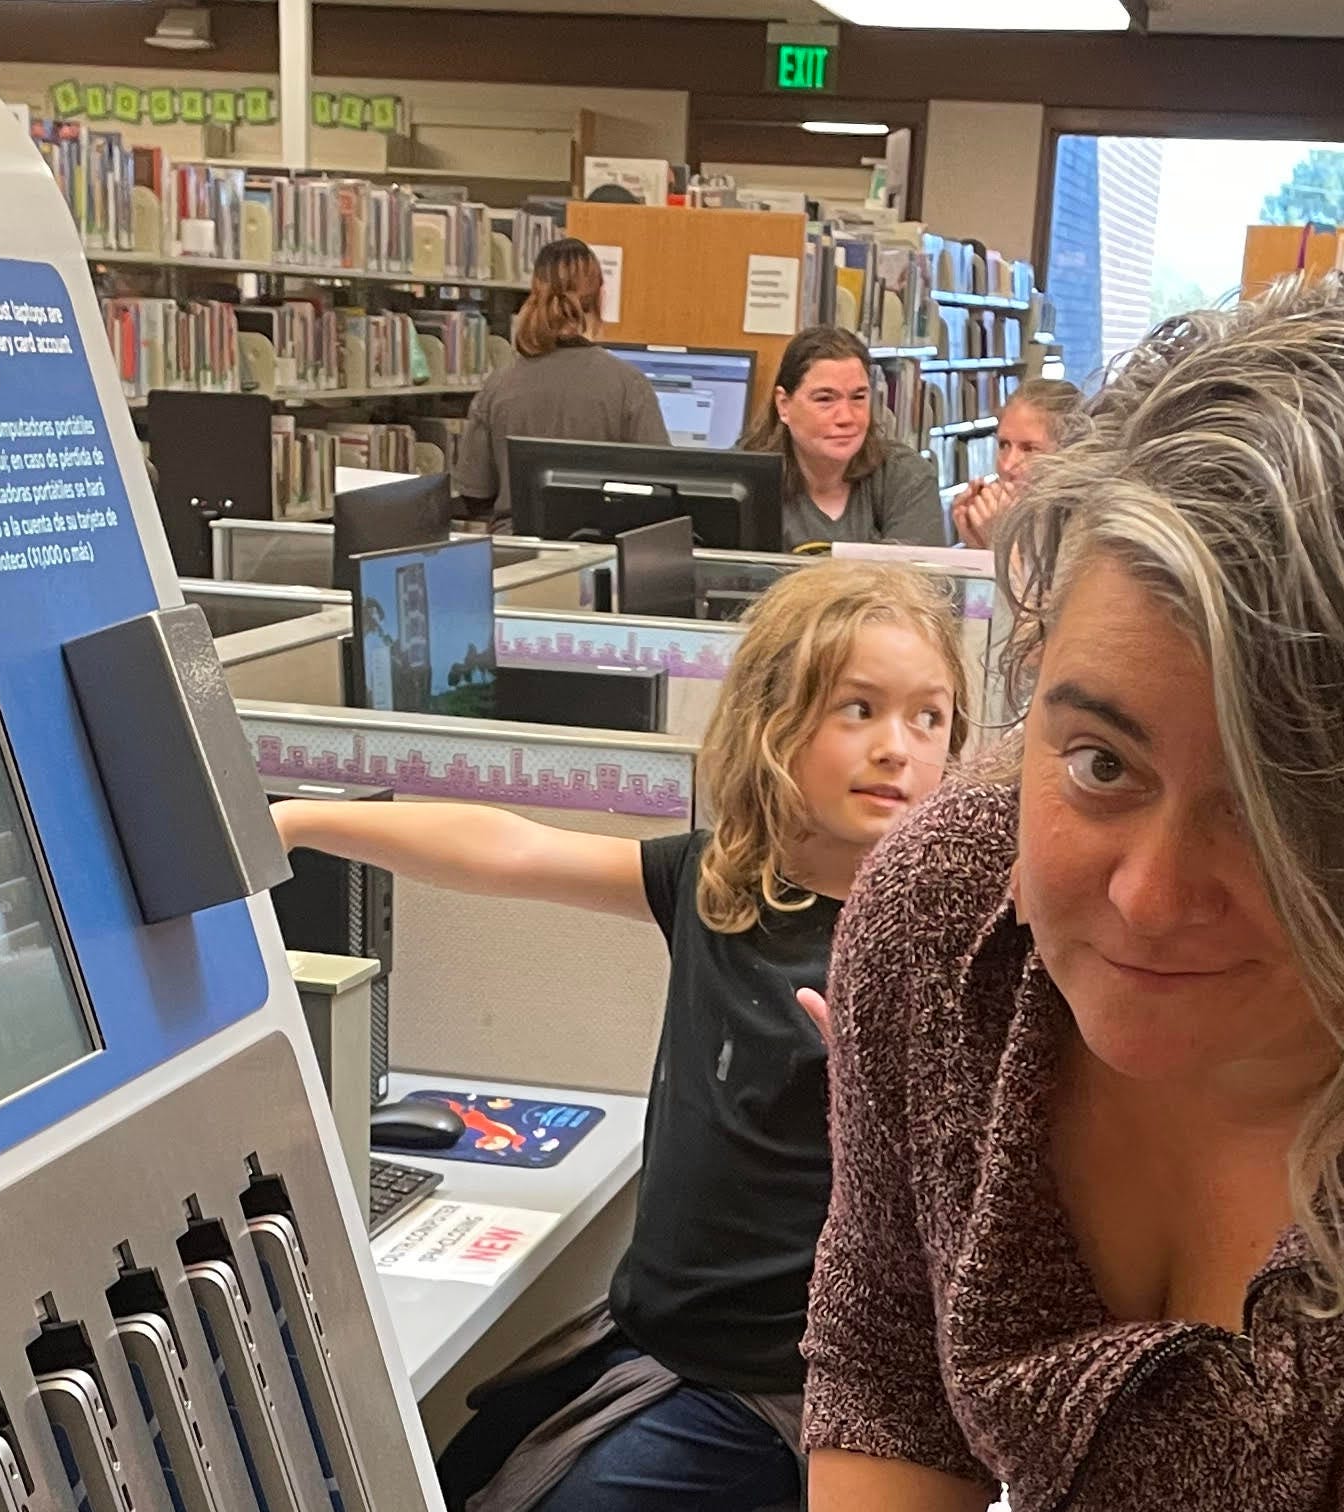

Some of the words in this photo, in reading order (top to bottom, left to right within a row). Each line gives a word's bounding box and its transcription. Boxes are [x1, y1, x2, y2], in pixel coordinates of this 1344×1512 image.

[779, 46, 827, 88] EXIT
[10, 300, 47, 324] laptops
[46, 306, 63, 323] are
[14, 332, 36, 353] card
[36, 335, 72, 353] account
[11, 454, 24, 470] en
[24, 453, 45, 469] caso
[46, 449, 58, 468] de
[92, 446, 104, 465] de
[75, 483, 86, 498] se
[3, 520, 10, 537] a
[10, 516, 21, 536] la
[22, 515, 53, 535] cuenta
[55, 512, 66, 532] de
[66, 515, 77, 530] su
[77, 508, 106, 532] tarjeta
[106, 507, 118, 527] de
[63, 549, 71, 563] o
[72, 541, 94, 562] más)
[459, 1225, 525, 1262] NEW
